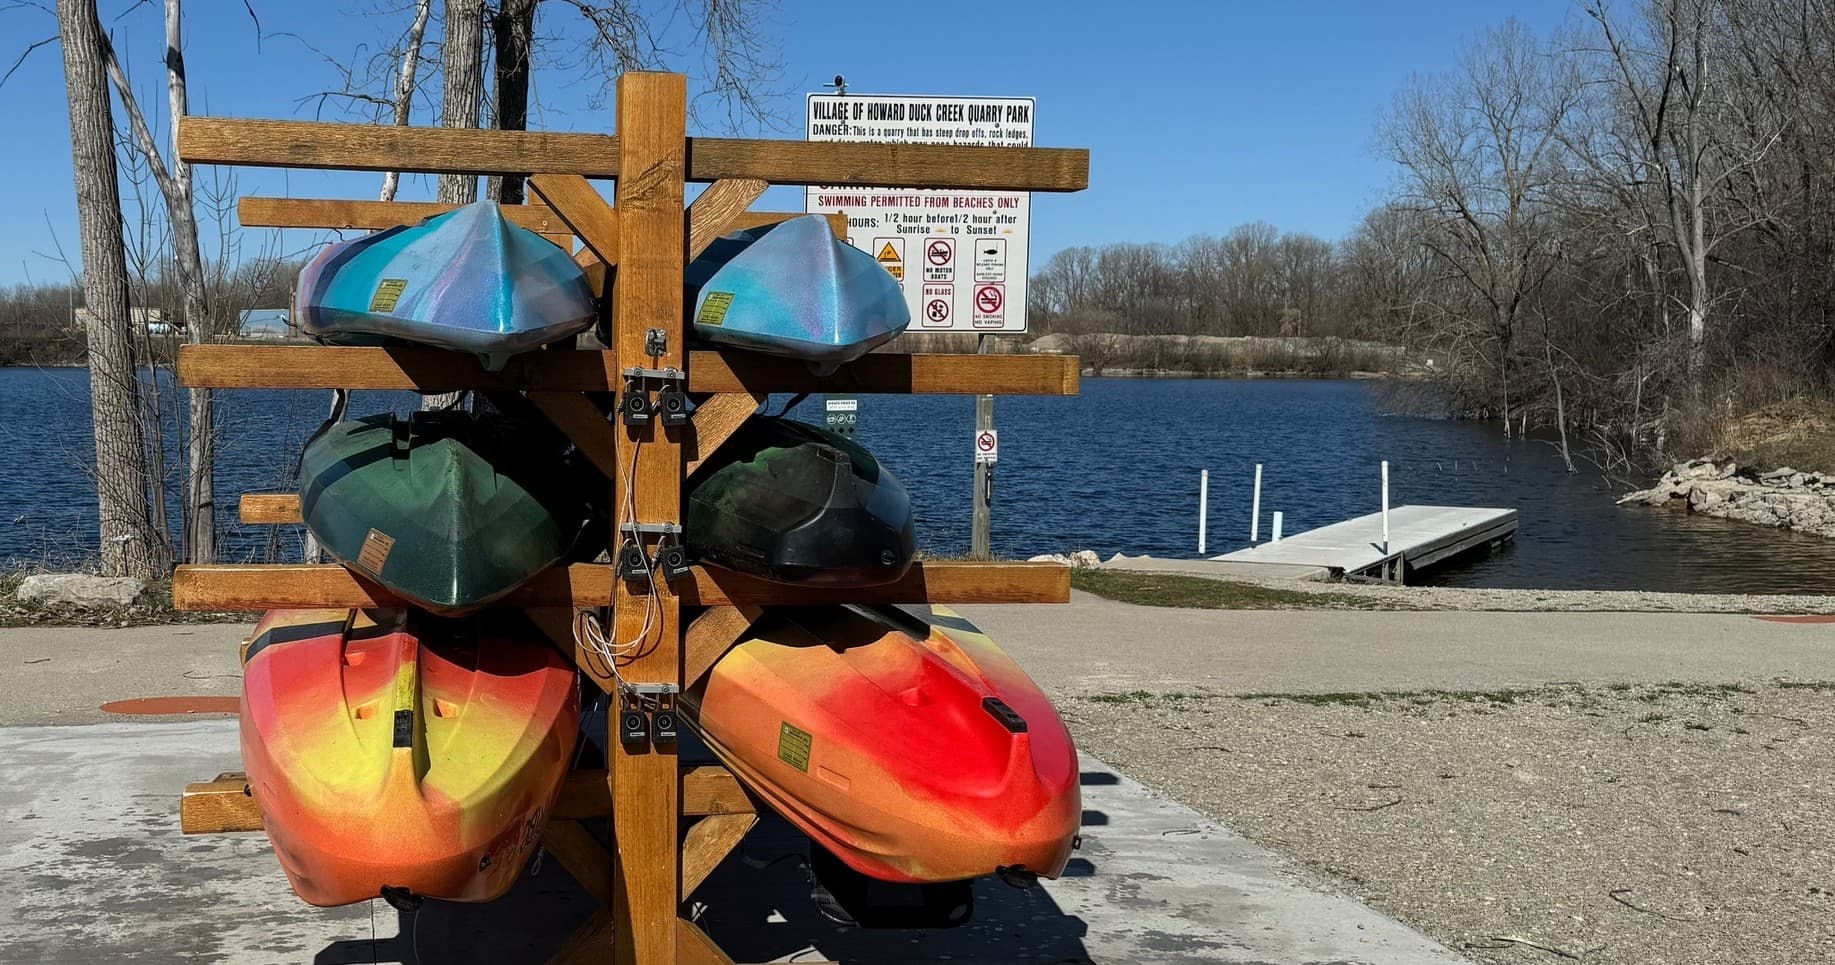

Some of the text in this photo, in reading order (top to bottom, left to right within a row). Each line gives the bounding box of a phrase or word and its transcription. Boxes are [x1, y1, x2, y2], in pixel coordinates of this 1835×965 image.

[813, 102, 1029, 125] VILLAGE OF HOWARD DUCK CREEK QUARRY PARK
[813, 124, 852, 136] DANGER:
[853, 126, 866, 136] This
[868, 126, 875, 136] is
[883, 129, 904, 139] quarry
[906, 127, 919, 137] that
[922, 127, 932, 137] has
[936, 127, 953, 139] steep
[955, 127, 969, 139] drop
[989, 127, 1003, 138] rock
[818, 196, 1019, 208] SWIMMING PERMITTED FROM BEACHES ONLY
[885, 213, 899, 222] 1/2
[903, 214, 922, 223] hour
[972, 214, 991, 224] hour
[995, 214, 1017, 224] after
[896, 224, 997, 234] Sunrise to Sunset
